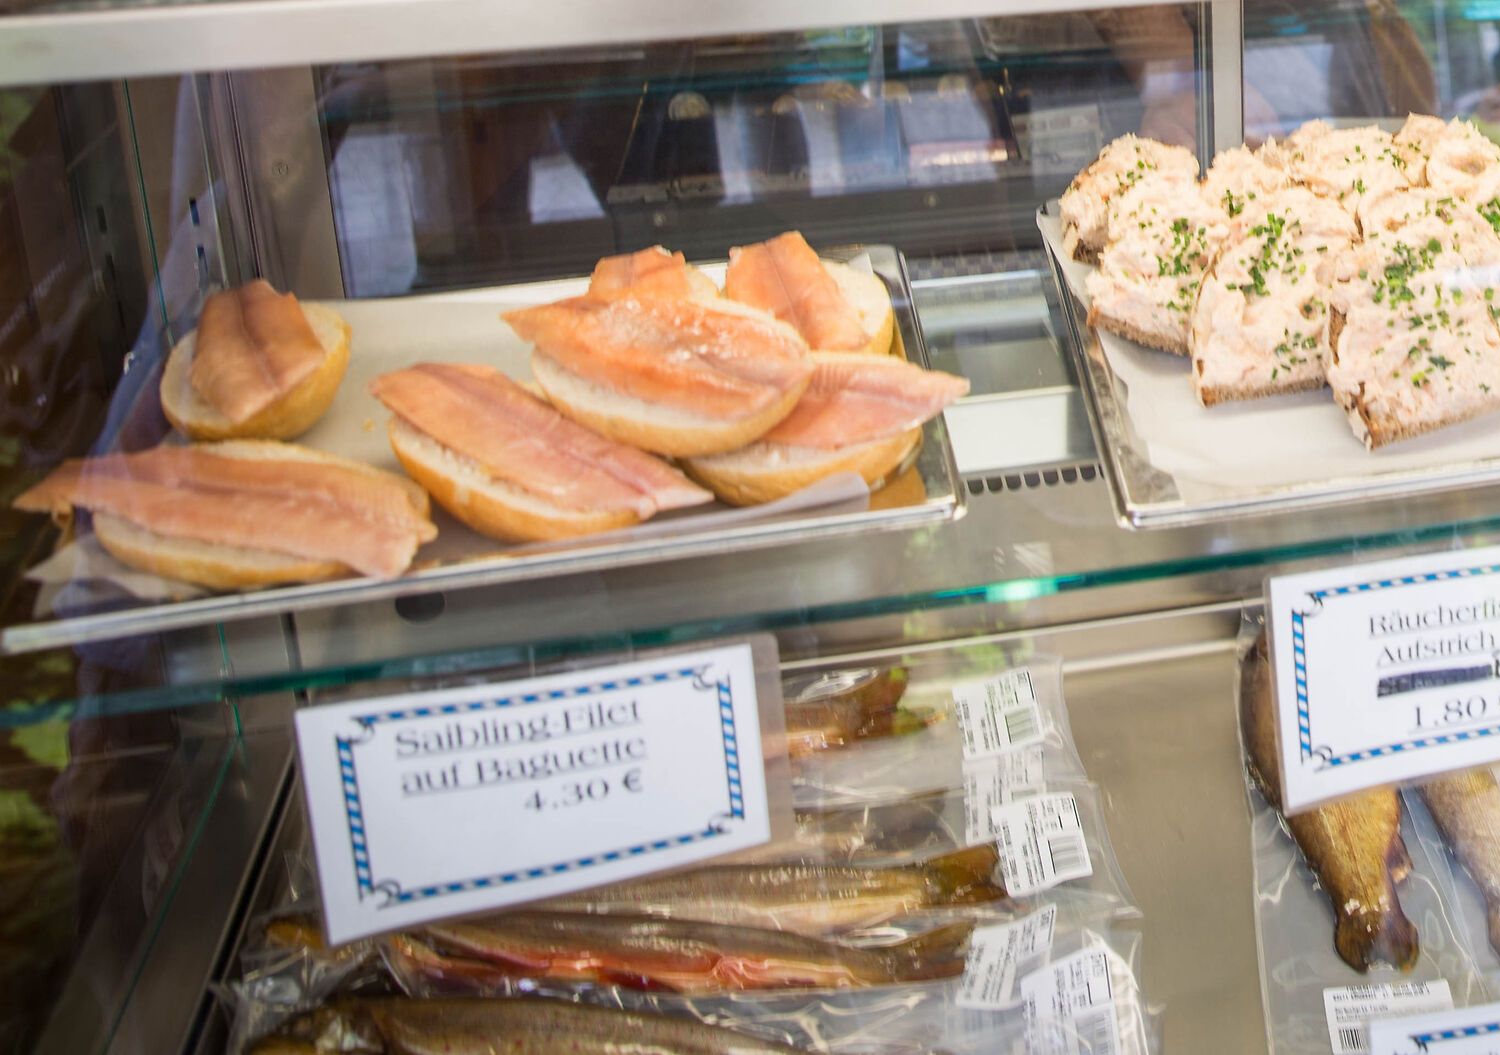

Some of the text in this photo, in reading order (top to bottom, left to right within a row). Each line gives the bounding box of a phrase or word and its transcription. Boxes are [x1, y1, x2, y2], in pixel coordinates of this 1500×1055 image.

[1377, 630, 1496, 666] Aufstrich
[396, 700, 641, 757] Saibling-Filet
[1413, 696, 1487, 729] 1.80
[401, 737, 646, 795] auf Baguette
[524, 769, 643, 812] 4.30 €
